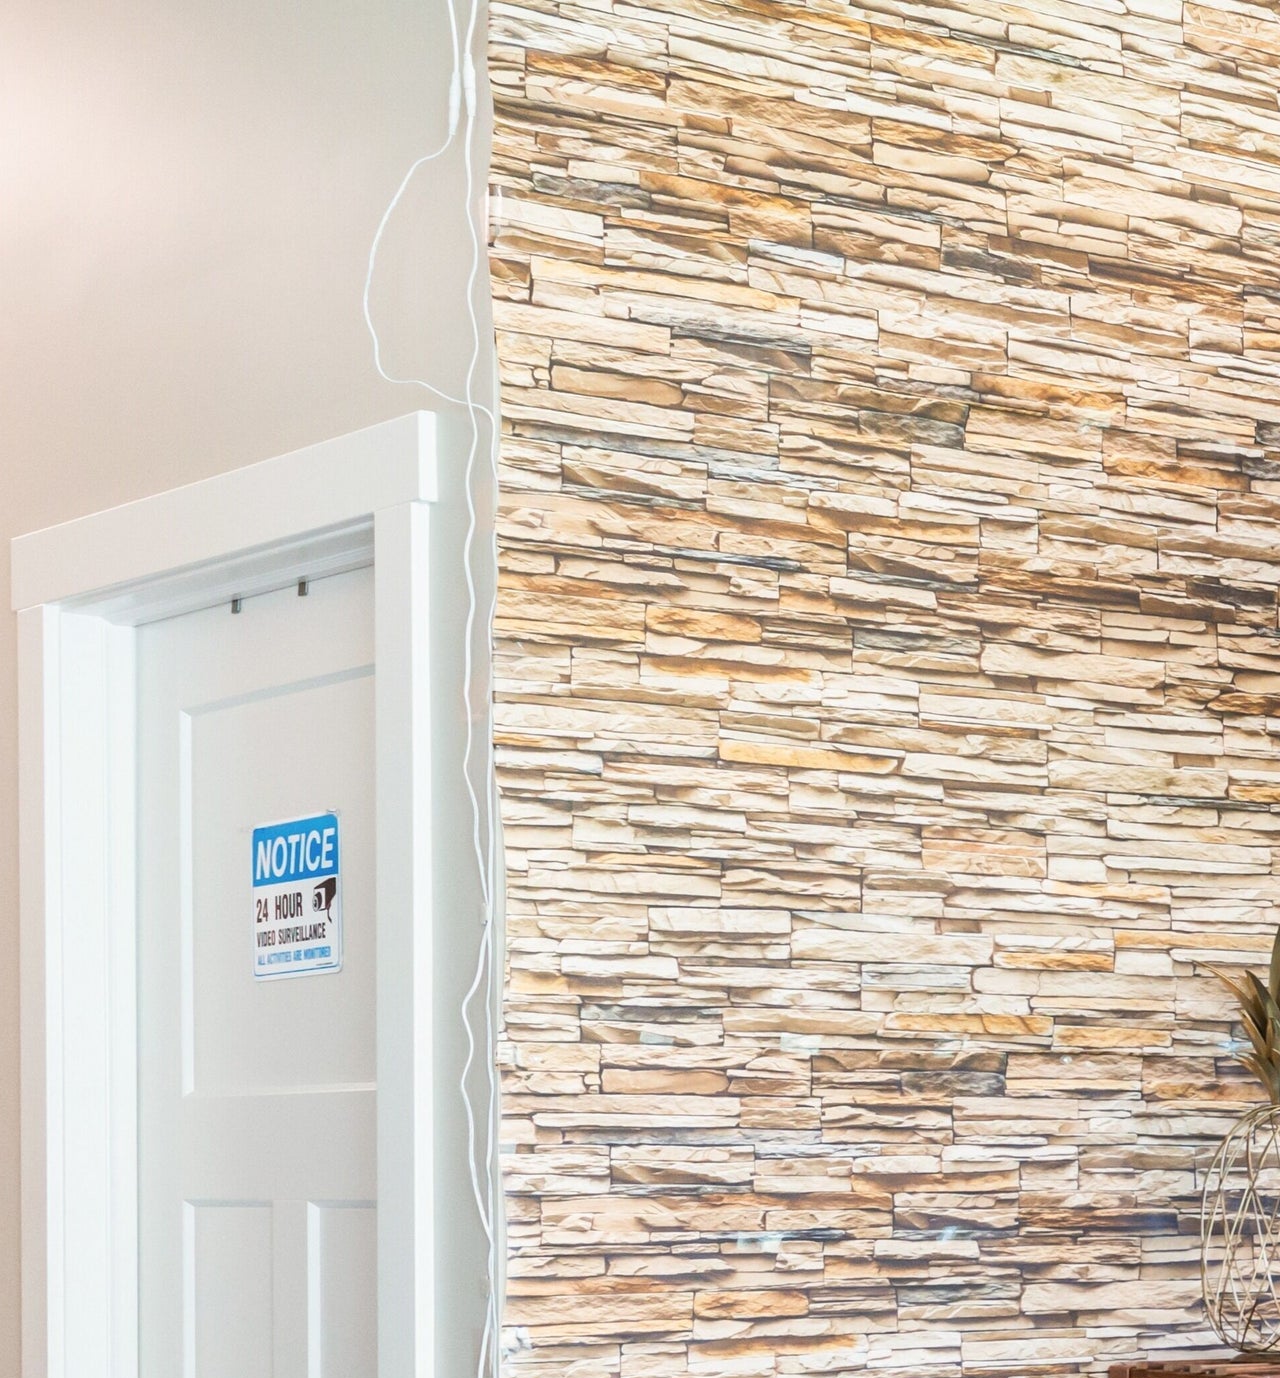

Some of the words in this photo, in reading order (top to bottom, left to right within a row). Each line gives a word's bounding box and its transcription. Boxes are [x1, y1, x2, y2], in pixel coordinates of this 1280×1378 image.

[256, 828, 335, 880] NOTICE
[256, 898, 269, 923] 24
[275, 892, 303, 920] HOUR
[257, 930, 276, 948] VIDEO
[278, 922, 326, 945] SURVEILLANCE
